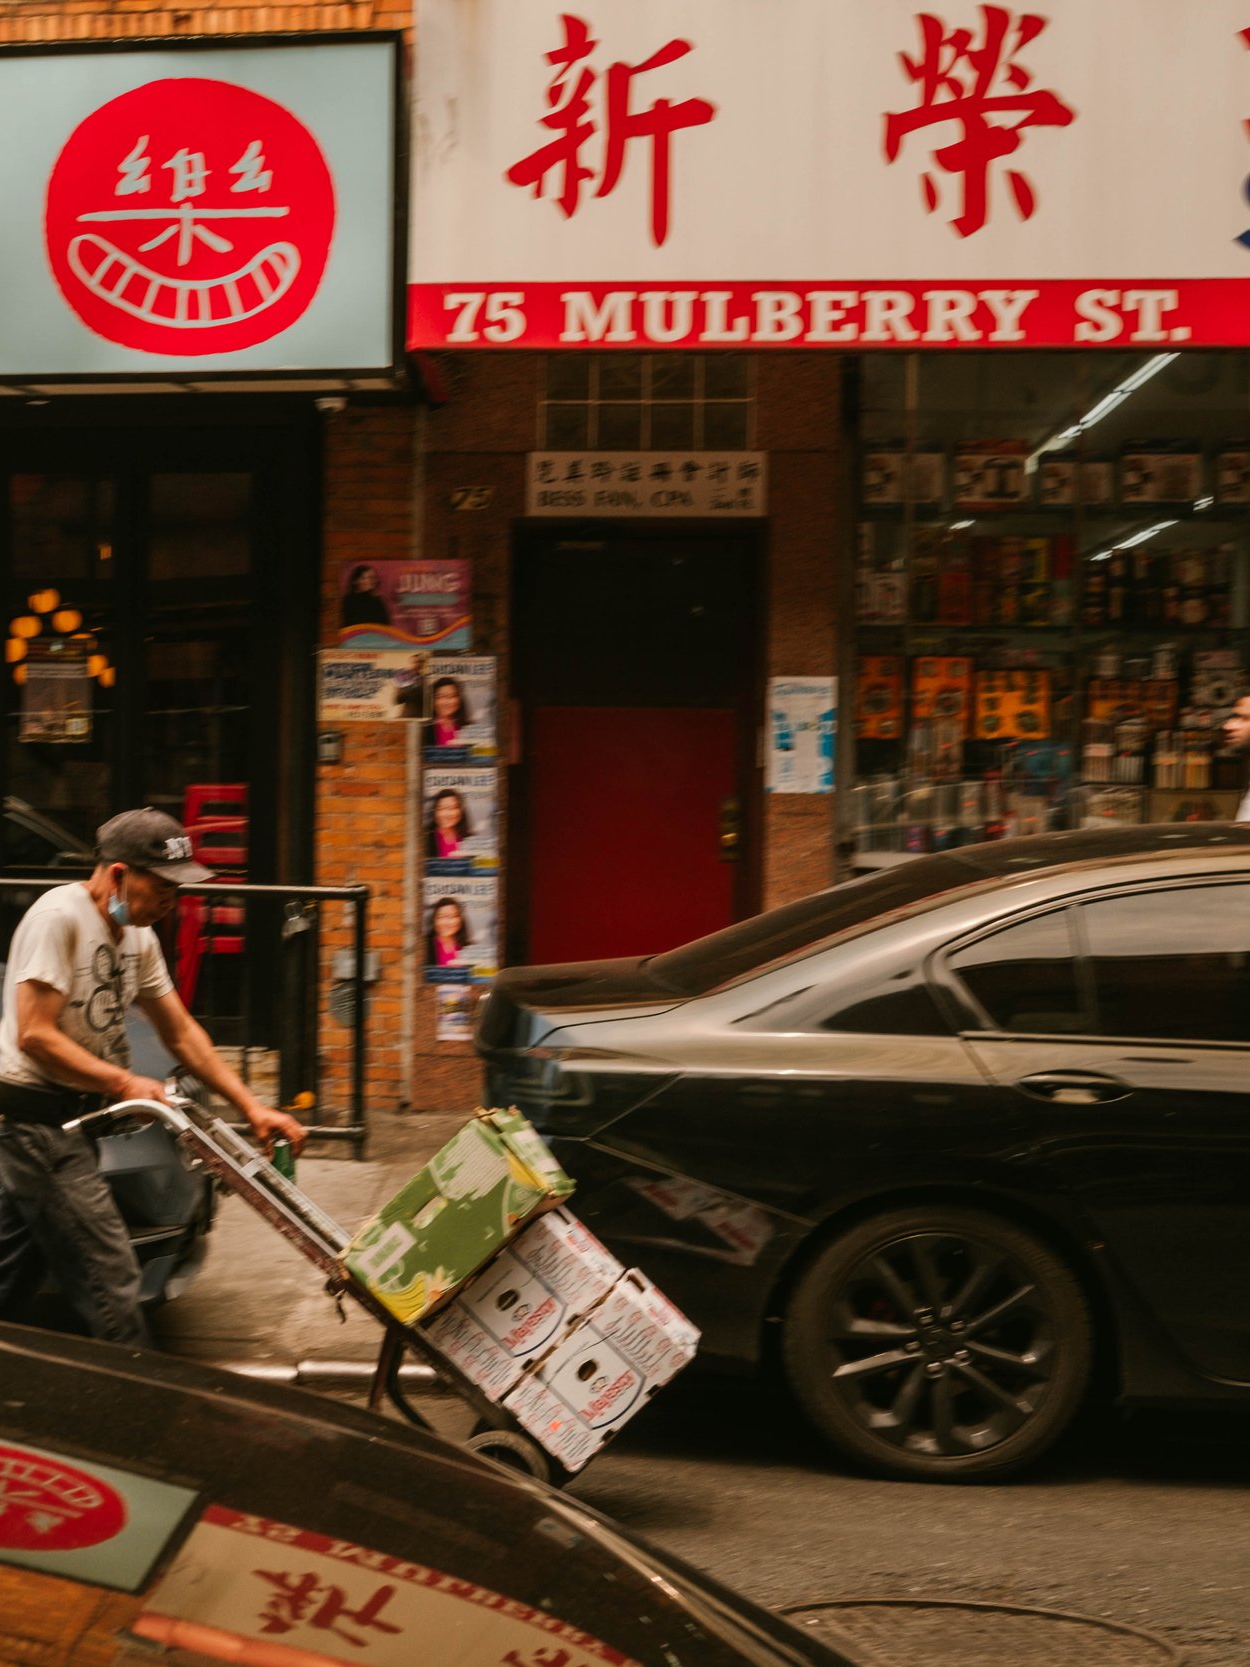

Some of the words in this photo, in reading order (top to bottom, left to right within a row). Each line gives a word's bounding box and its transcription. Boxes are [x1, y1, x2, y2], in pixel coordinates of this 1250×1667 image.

[75, 133, 291, 267] 樂
[443, 291, 526, 344] 75
[560, 289, 1038, 344] MULBERRY
[1074, 288, 1191, 343] ST.
[536, 489, 587, 508] BESS
[650, 489, 694, 508] CPA
